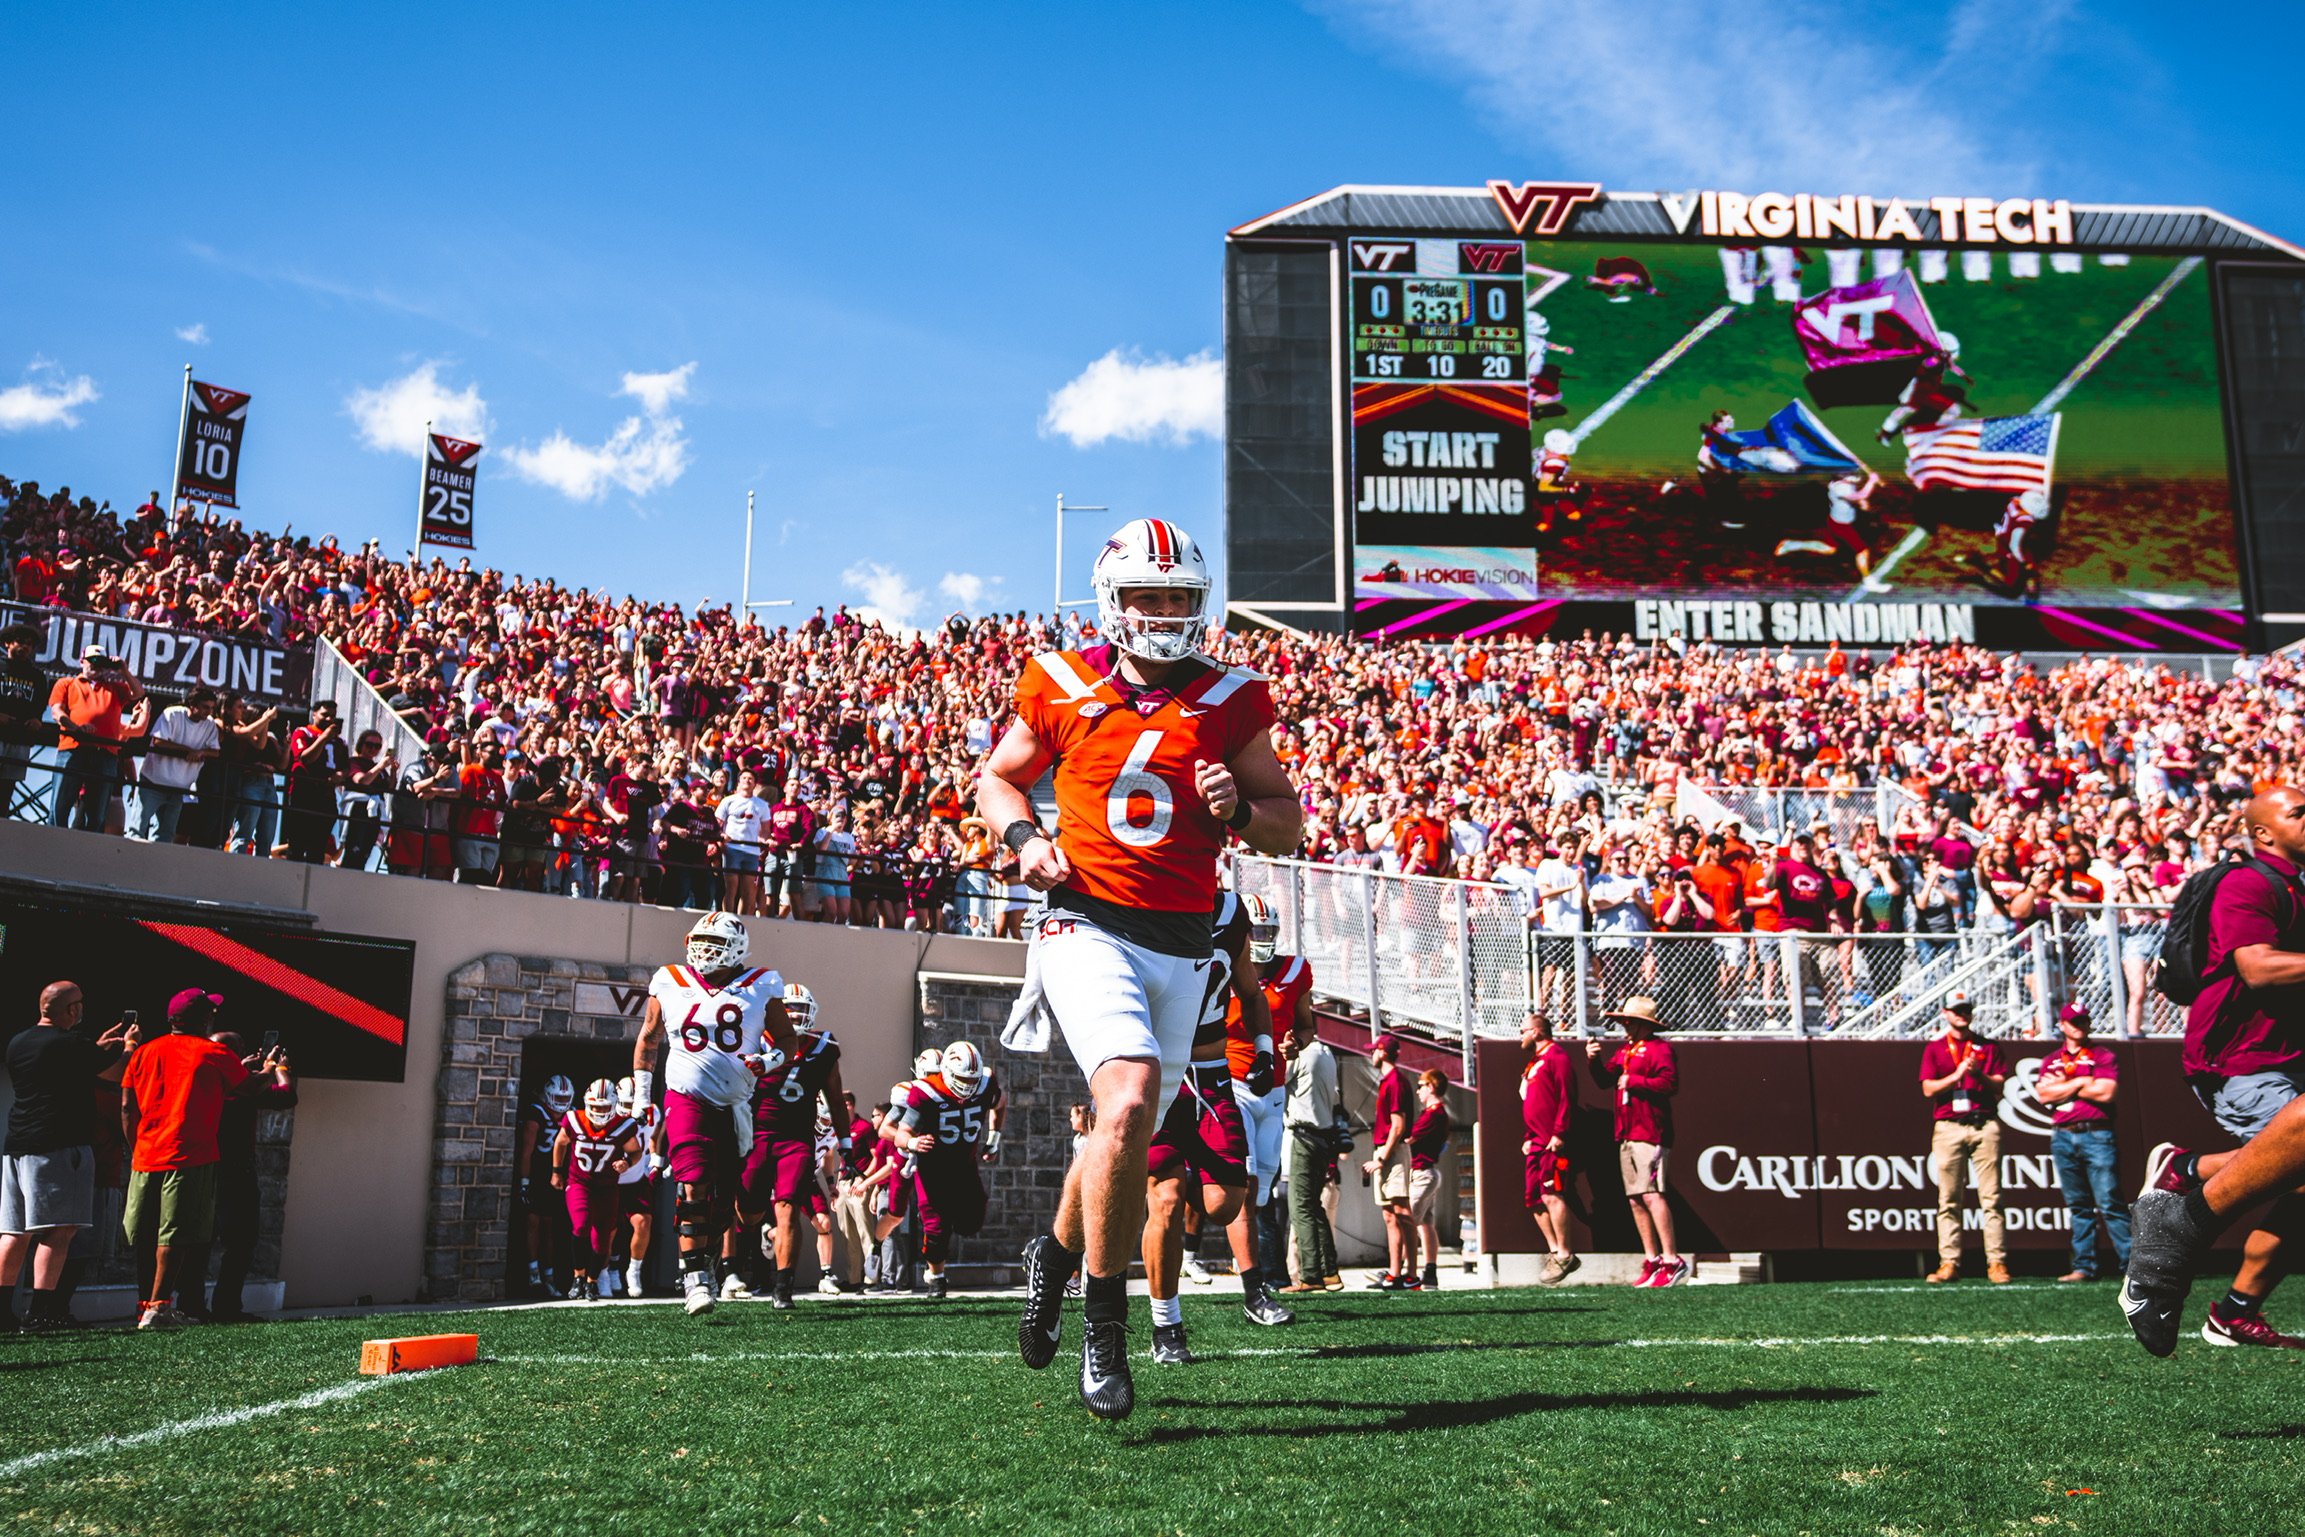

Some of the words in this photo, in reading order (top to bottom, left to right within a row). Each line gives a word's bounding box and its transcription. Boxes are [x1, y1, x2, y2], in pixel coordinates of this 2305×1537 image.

[1488, 181, 1601, 235] VT
[1657, 190, 1923, 241] VIRGINIA
[1930, 195, 2074, 244] TECH
[1353, 244, 1410, 271] VT
[1462, 244, 1522, 272] VT
[1370, 285, 1390, 319] 0
[1412, 301, 1464, 323] 3:31
[1487, 288, 1507, 321] 0
[1366, 354, 1404, 375] 1ST
[1427, 355, 1455, 377] 10
[1481, 356, 1511, 378] 20
[197, 420, 232, 442] LORIA
[194, 439, 230, 480] 10
[1382, 431, 1500, 469] START
[182, 485, 233, 504] HOKIES
[429, 467, 472, 490] BEAMER
[427, 485, 471, 525] 25
[1358, 476, 1526, 515] JUMPING
[425, 531, 471, 545] HOKIES
[1415, 568, 1534, 585] HOKIEVISION
[1634, 599, 1764, 642] ENTER
[1771, 602, 1976, 644] SANDMAN
[35, 615, 285, 696] JUMPZONE
[325, 743, 336, 769] 1
[762, 754, 777, 769] 25
[1107, 729, 1173, 847] 6
[680, 1003, 743, 1053] 68
[779, 1066, 805, 1102] 6
[938, 1105, 982, 1144] 55
[574, 1140, 616, 1173] 57
[1697, 1145, 1925, 1199] CARILION
[1848, 1207, 1937, 1232] SPORT
[1962, 1207, 2072, 1231] MDICI
